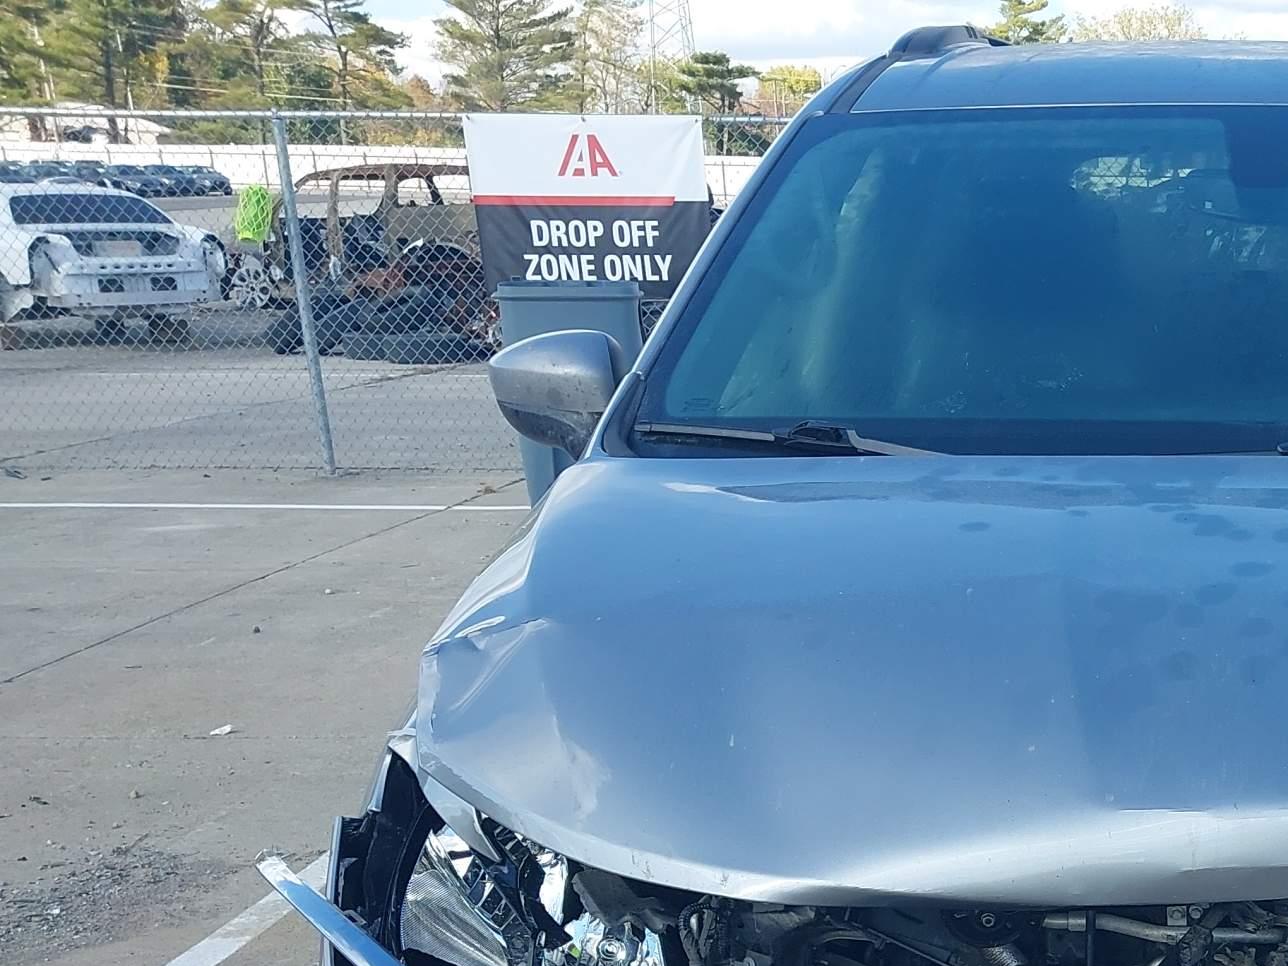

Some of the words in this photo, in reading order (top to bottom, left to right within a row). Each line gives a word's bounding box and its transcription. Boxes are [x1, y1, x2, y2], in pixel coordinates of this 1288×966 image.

[530, 220, 604, 248] DROP
[612, 220, 660, 248] OFF
[523, 254, 597, 281] ZONE
[604, 254, 673, 281] ONLY
